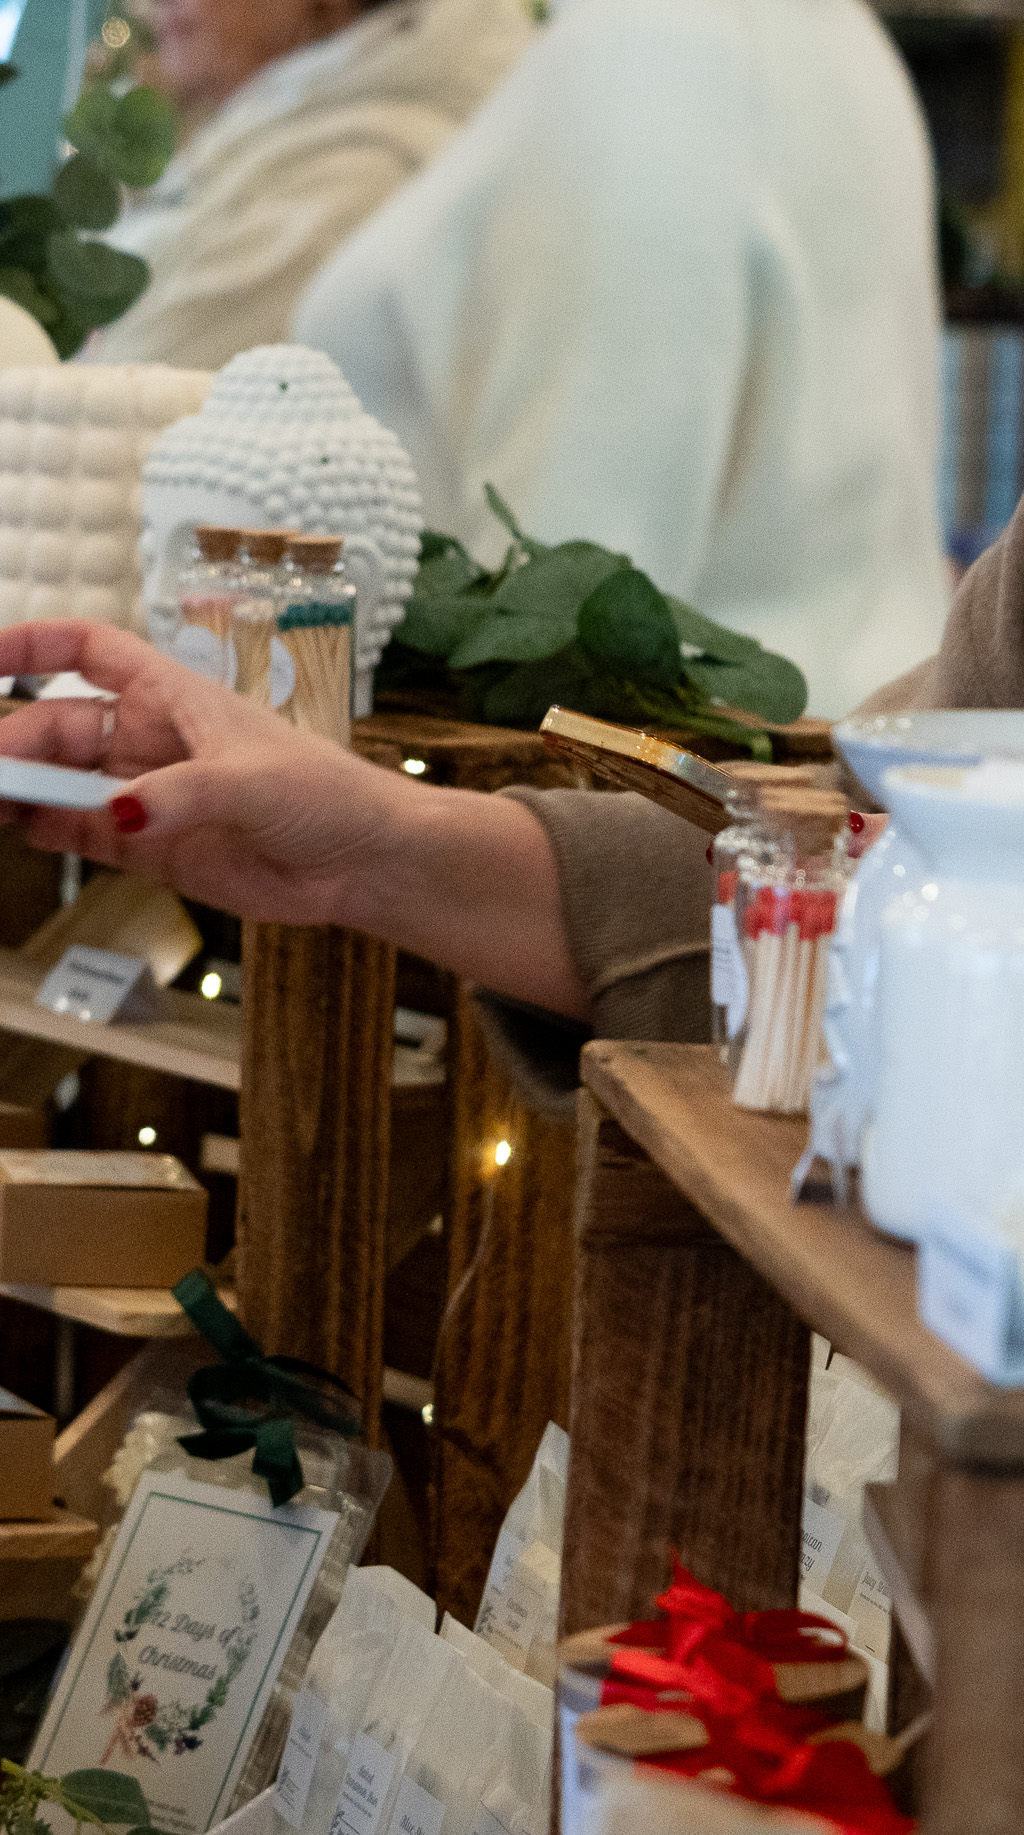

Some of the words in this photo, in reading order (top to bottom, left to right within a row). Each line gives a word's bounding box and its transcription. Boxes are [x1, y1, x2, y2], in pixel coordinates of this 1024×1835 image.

[171, 1612, 217, 1642] Days
[219, 1626, 241, 1650] of
[138, 1644, 218, 1680] Christmas
